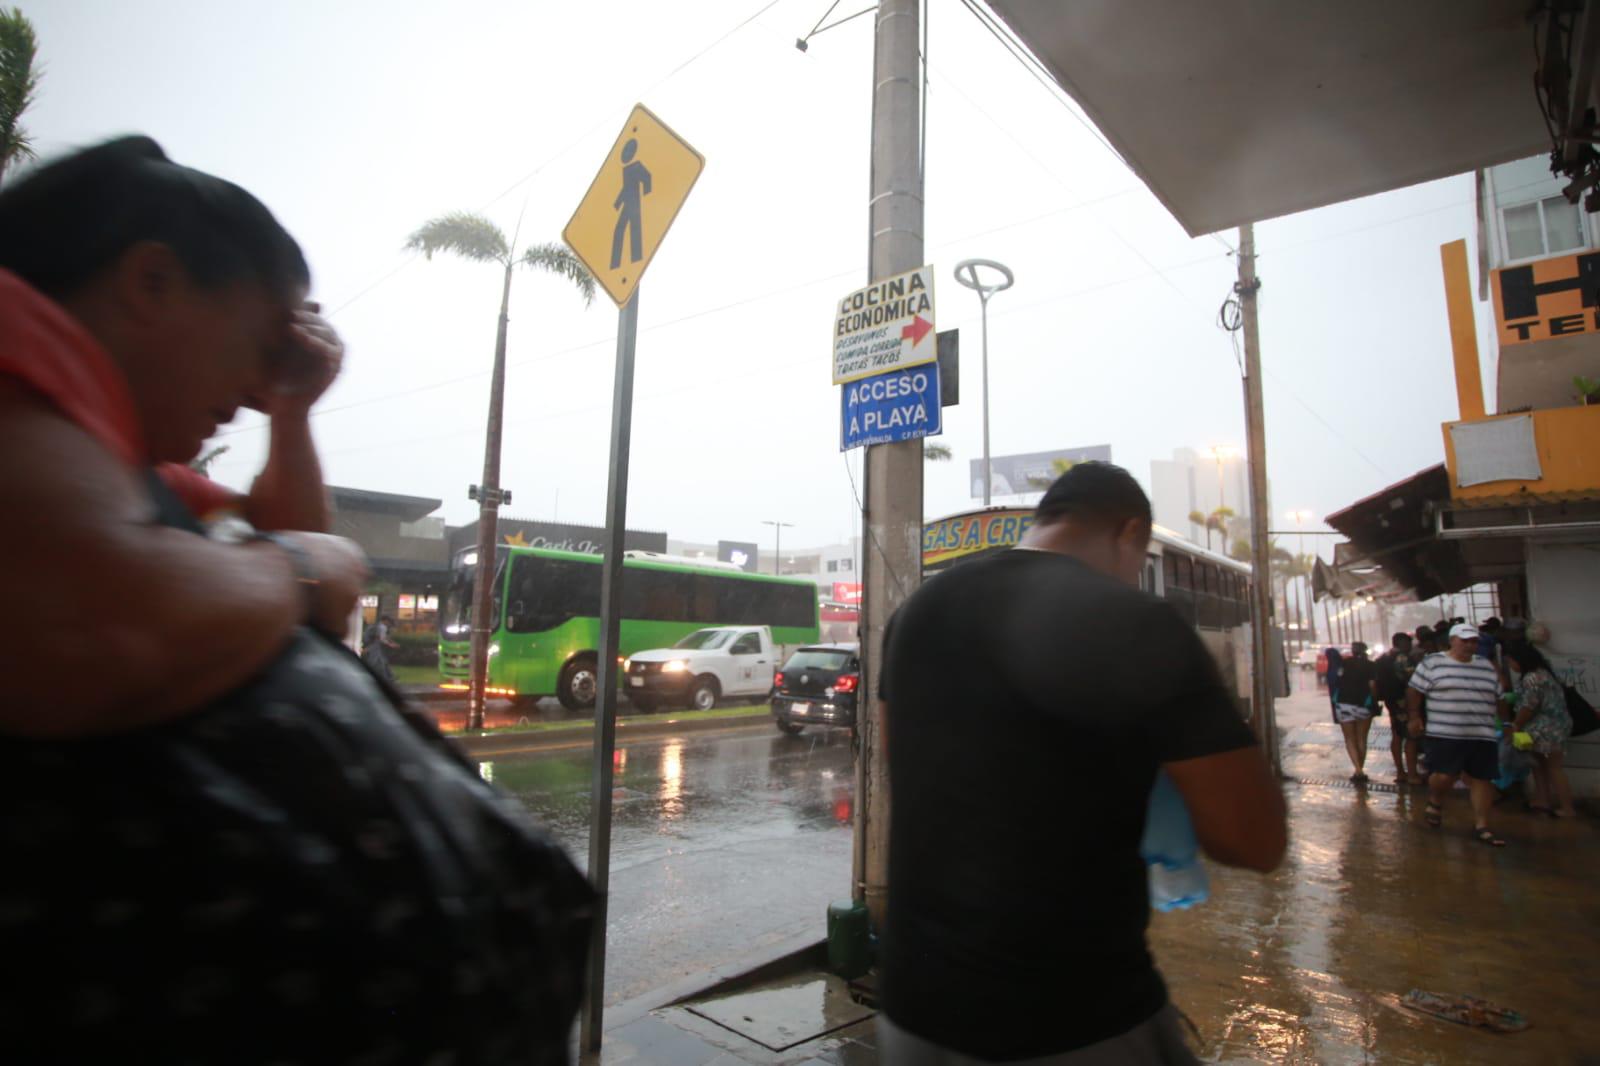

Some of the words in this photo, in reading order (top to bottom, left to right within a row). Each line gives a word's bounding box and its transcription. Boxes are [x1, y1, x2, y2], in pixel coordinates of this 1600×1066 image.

[841, 272, 926, 315] COCINA
[837, 293, 931, 337] ECONOMICA
[837, 357, 869, 376] TORTAS
[871, 350, 902, 368] TACOS
[848, 373, 928, 408] ACCESO
[849, 419, 860, 437] A
[864, 404, 928, 431] PLAYA
[964, 519, 982, 549] A
